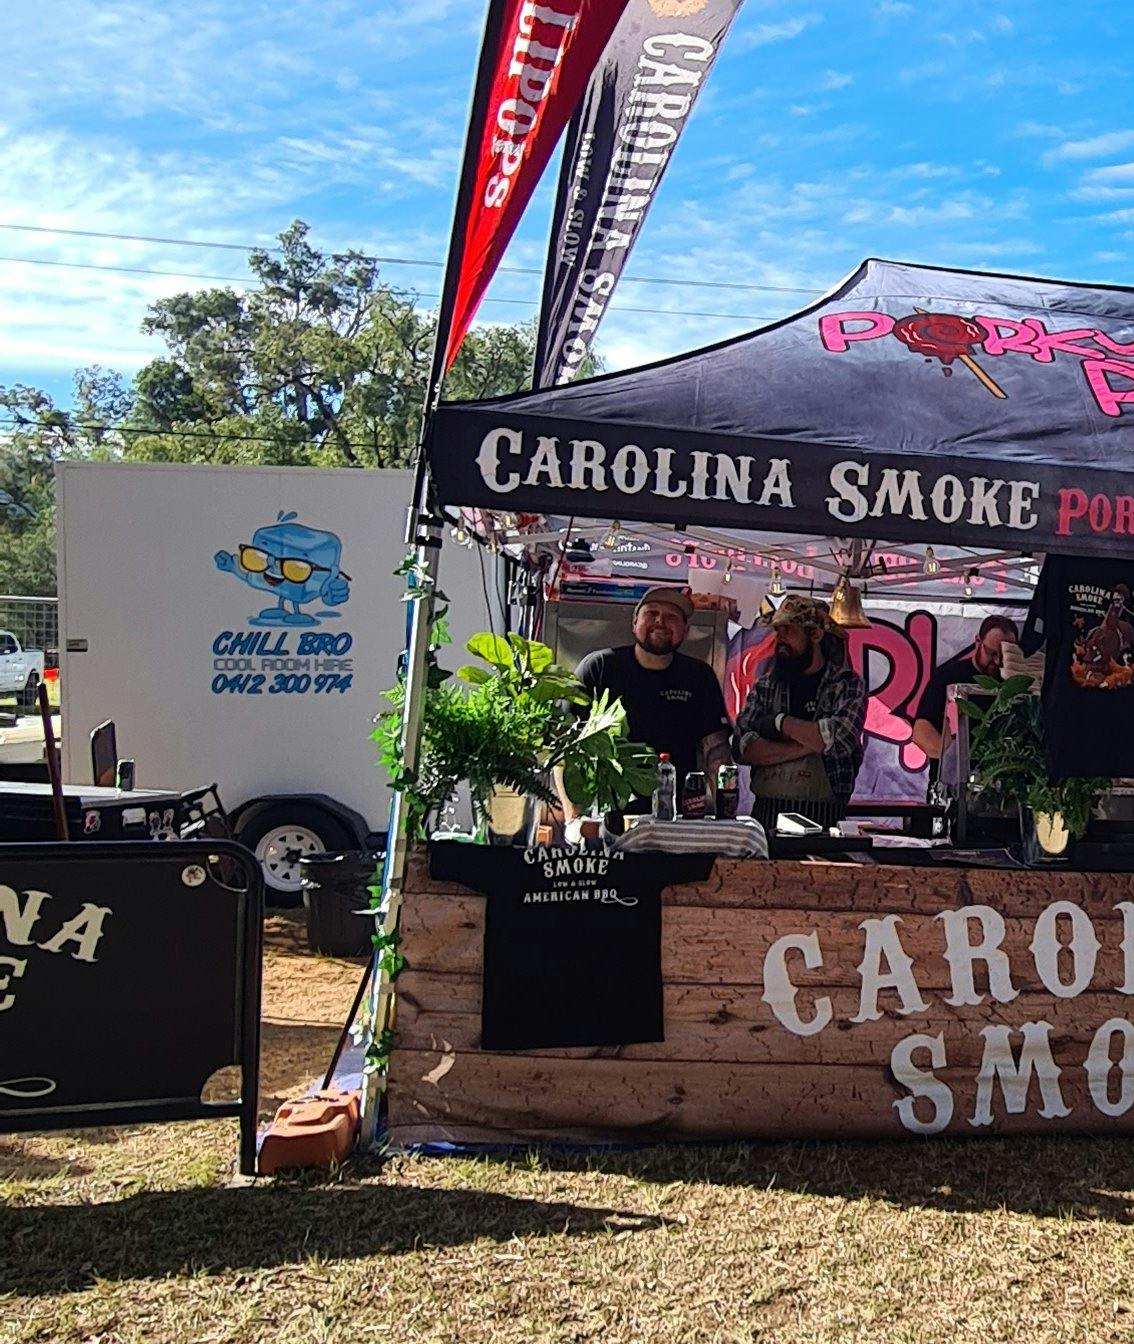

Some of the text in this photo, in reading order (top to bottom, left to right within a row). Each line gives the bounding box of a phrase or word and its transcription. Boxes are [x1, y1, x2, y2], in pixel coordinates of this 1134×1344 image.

[586, 32, 714, 251] CAROLINA
[560, 207, 585, 267] SLOW
[555, 270, 615, 386] SMO
[474, 427, 796, 509] CAROLINA
[825, 460, 1041, 530] SMOKE
[213, 631, 352, 656] CHILL BRO
[213, 658, 354, 671] COOL ROOM HIRE
[211, 674, 354, 694] 0412 300 974
[543, 857, 609, 878] SMOKE
[578, 879, 598, 887] SLOW
[523, 890, 589, 903] AMERICAN
